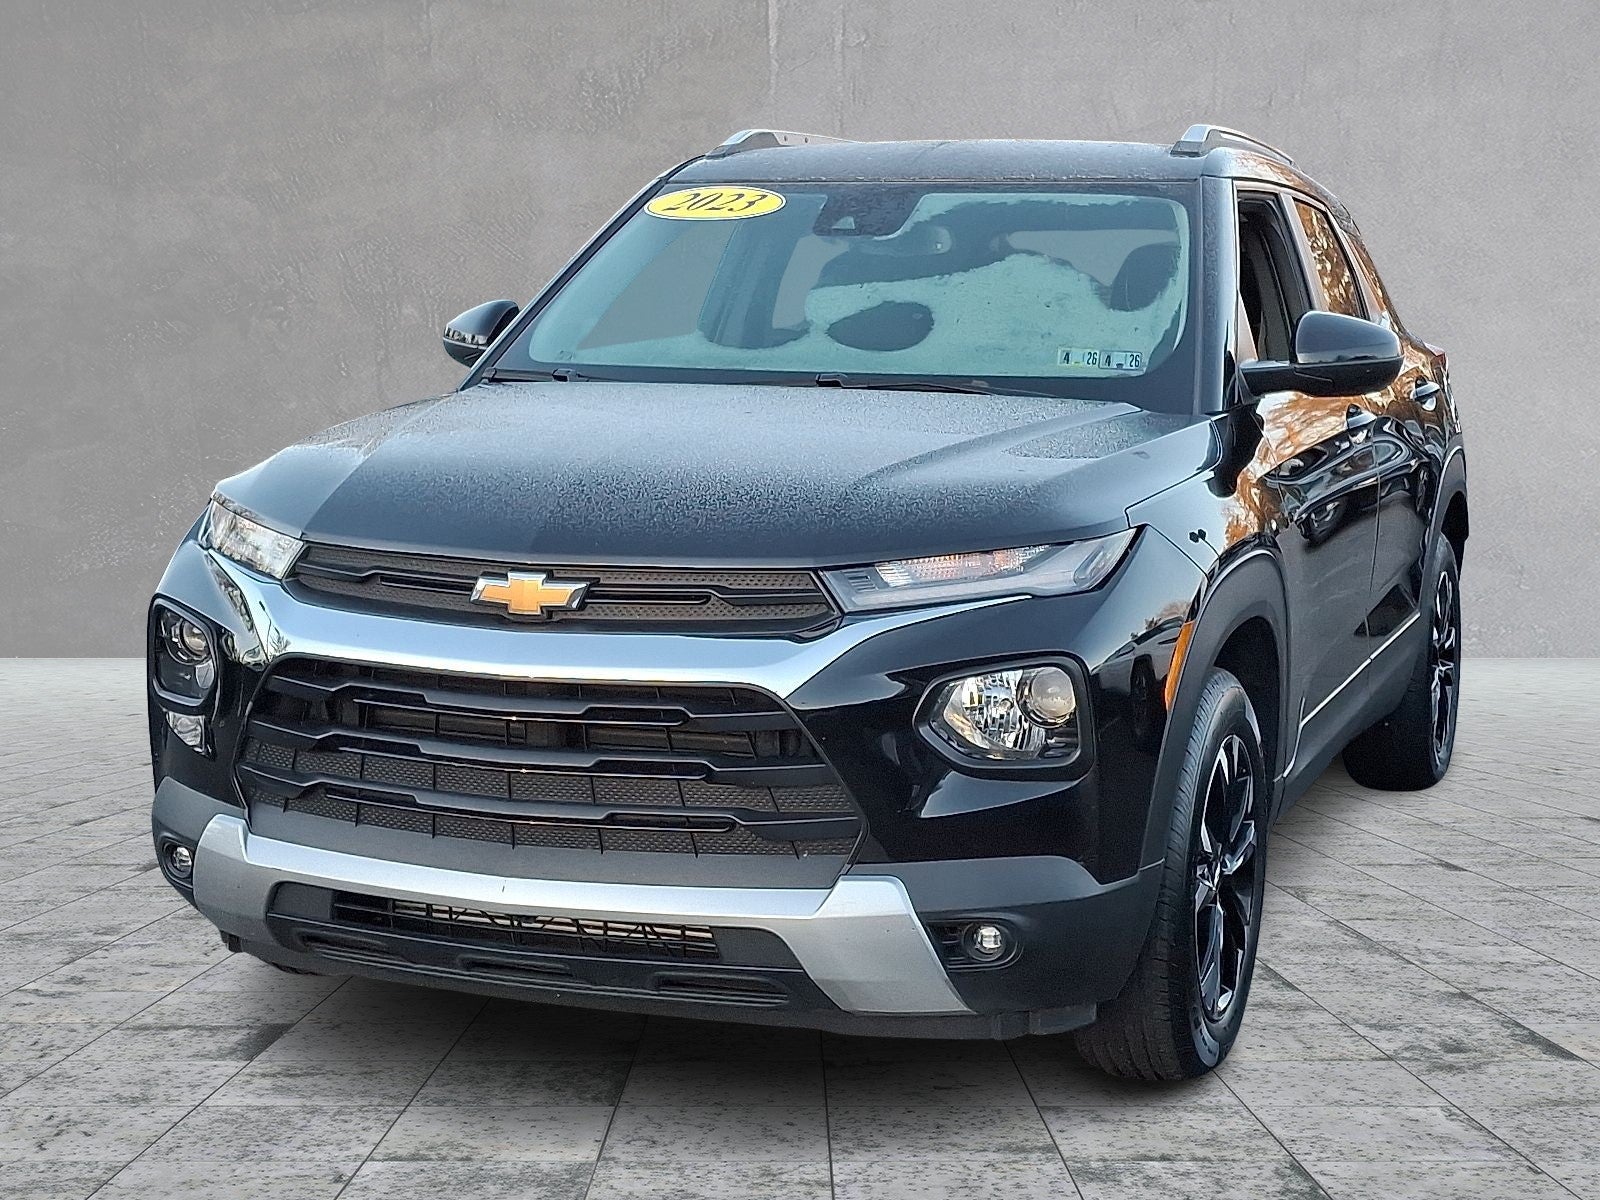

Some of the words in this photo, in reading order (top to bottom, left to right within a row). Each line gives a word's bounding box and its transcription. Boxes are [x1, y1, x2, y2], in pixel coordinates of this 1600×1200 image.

[661, 192, 768, 212] 2023
[1063, 352, 1070, 364] 4
[1086, 352, 1098, 366] 26
[1105, 354, 1111, 367] 4
[1129, 353, 1140, 368] 26
